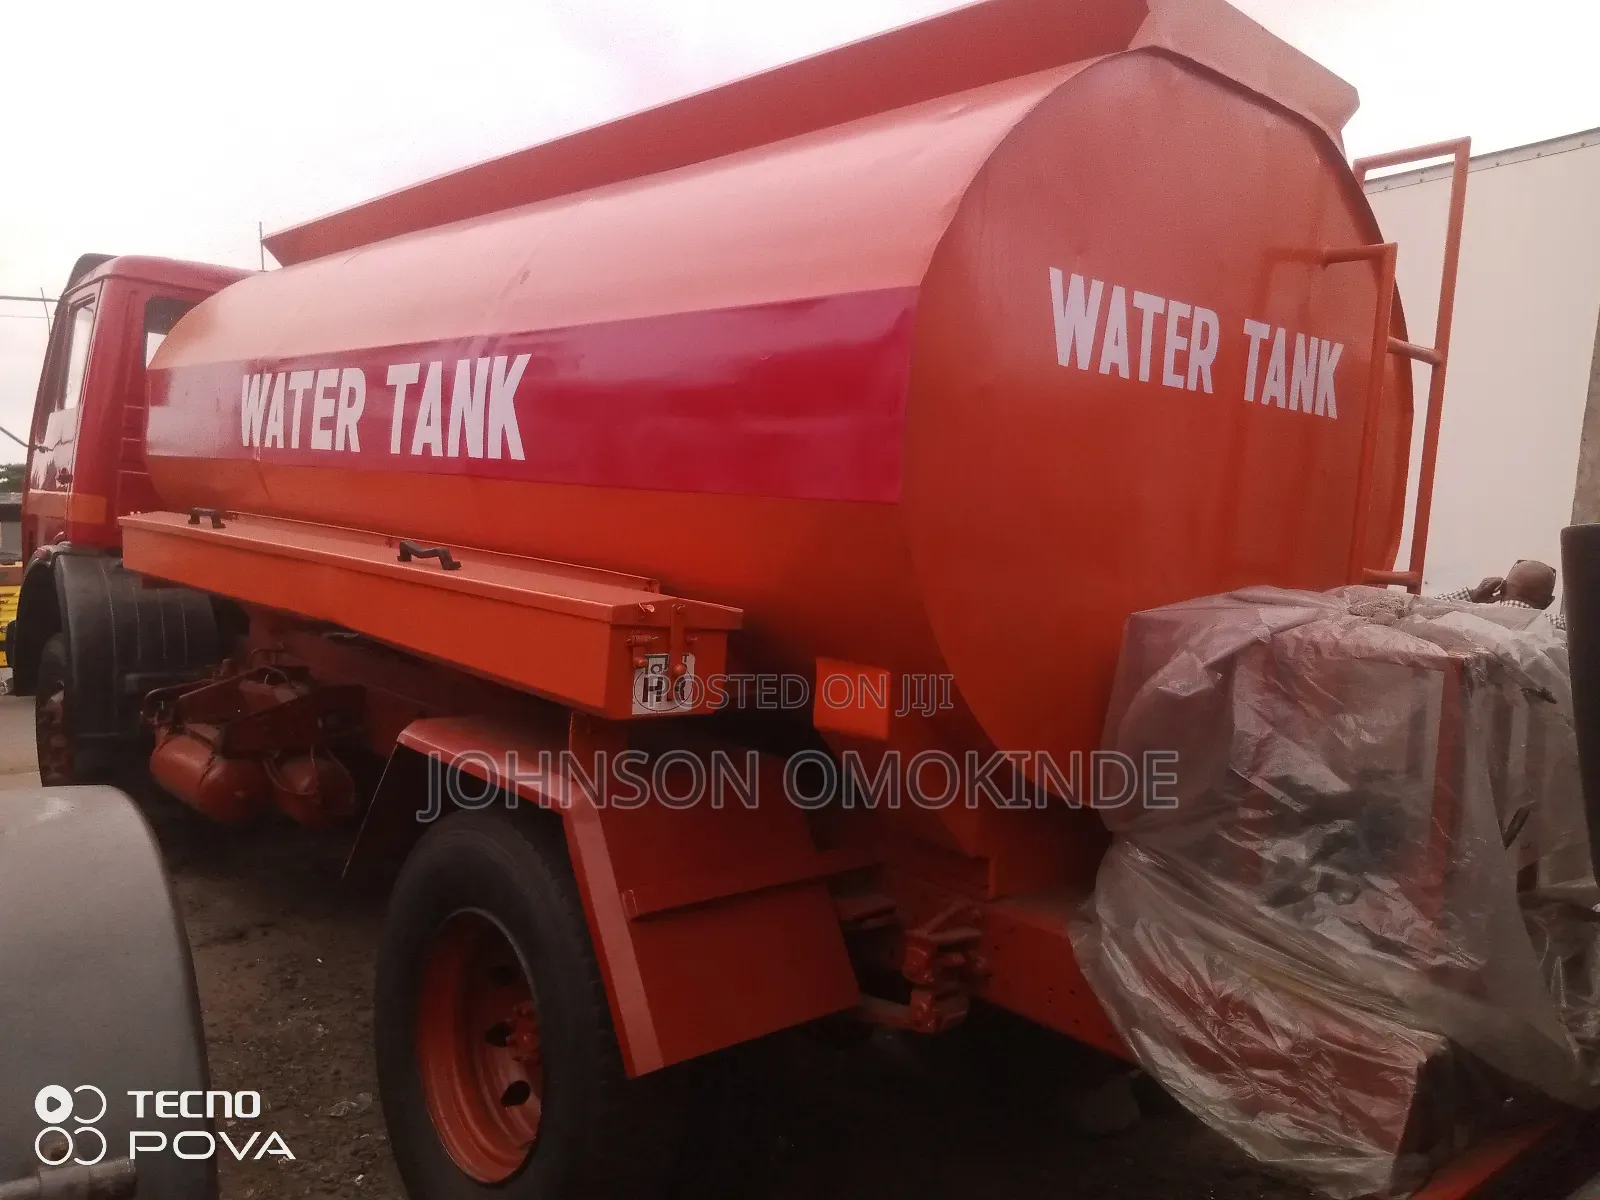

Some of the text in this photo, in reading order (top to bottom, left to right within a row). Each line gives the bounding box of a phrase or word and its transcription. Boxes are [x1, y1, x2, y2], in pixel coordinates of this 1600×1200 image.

[241, 353, 532, 461] WATER TANK
[1049, 267, 1344, 420] WATER TANK
